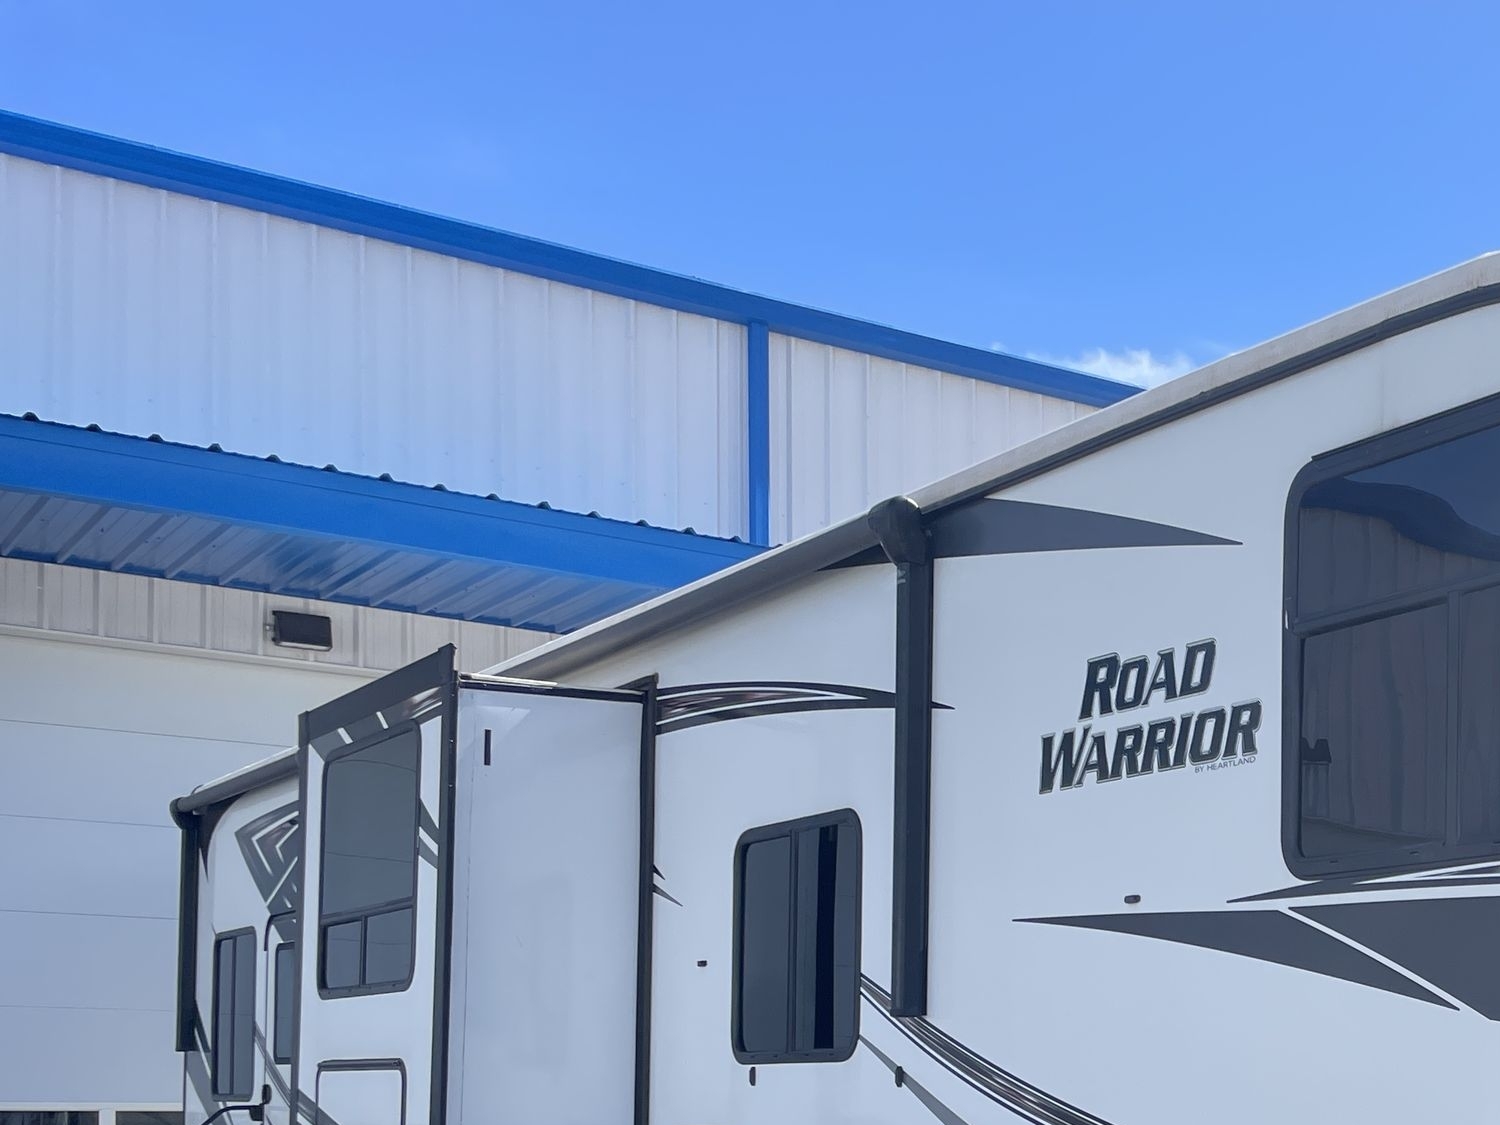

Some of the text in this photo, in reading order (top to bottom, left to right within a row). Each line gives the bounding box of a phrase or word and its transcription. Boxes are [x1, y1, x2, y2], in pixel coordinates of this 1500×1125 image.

[1038, 697, 1262, 795] WARRIOR
[1194, 755, 1257, 774] BY HEARTLAND
